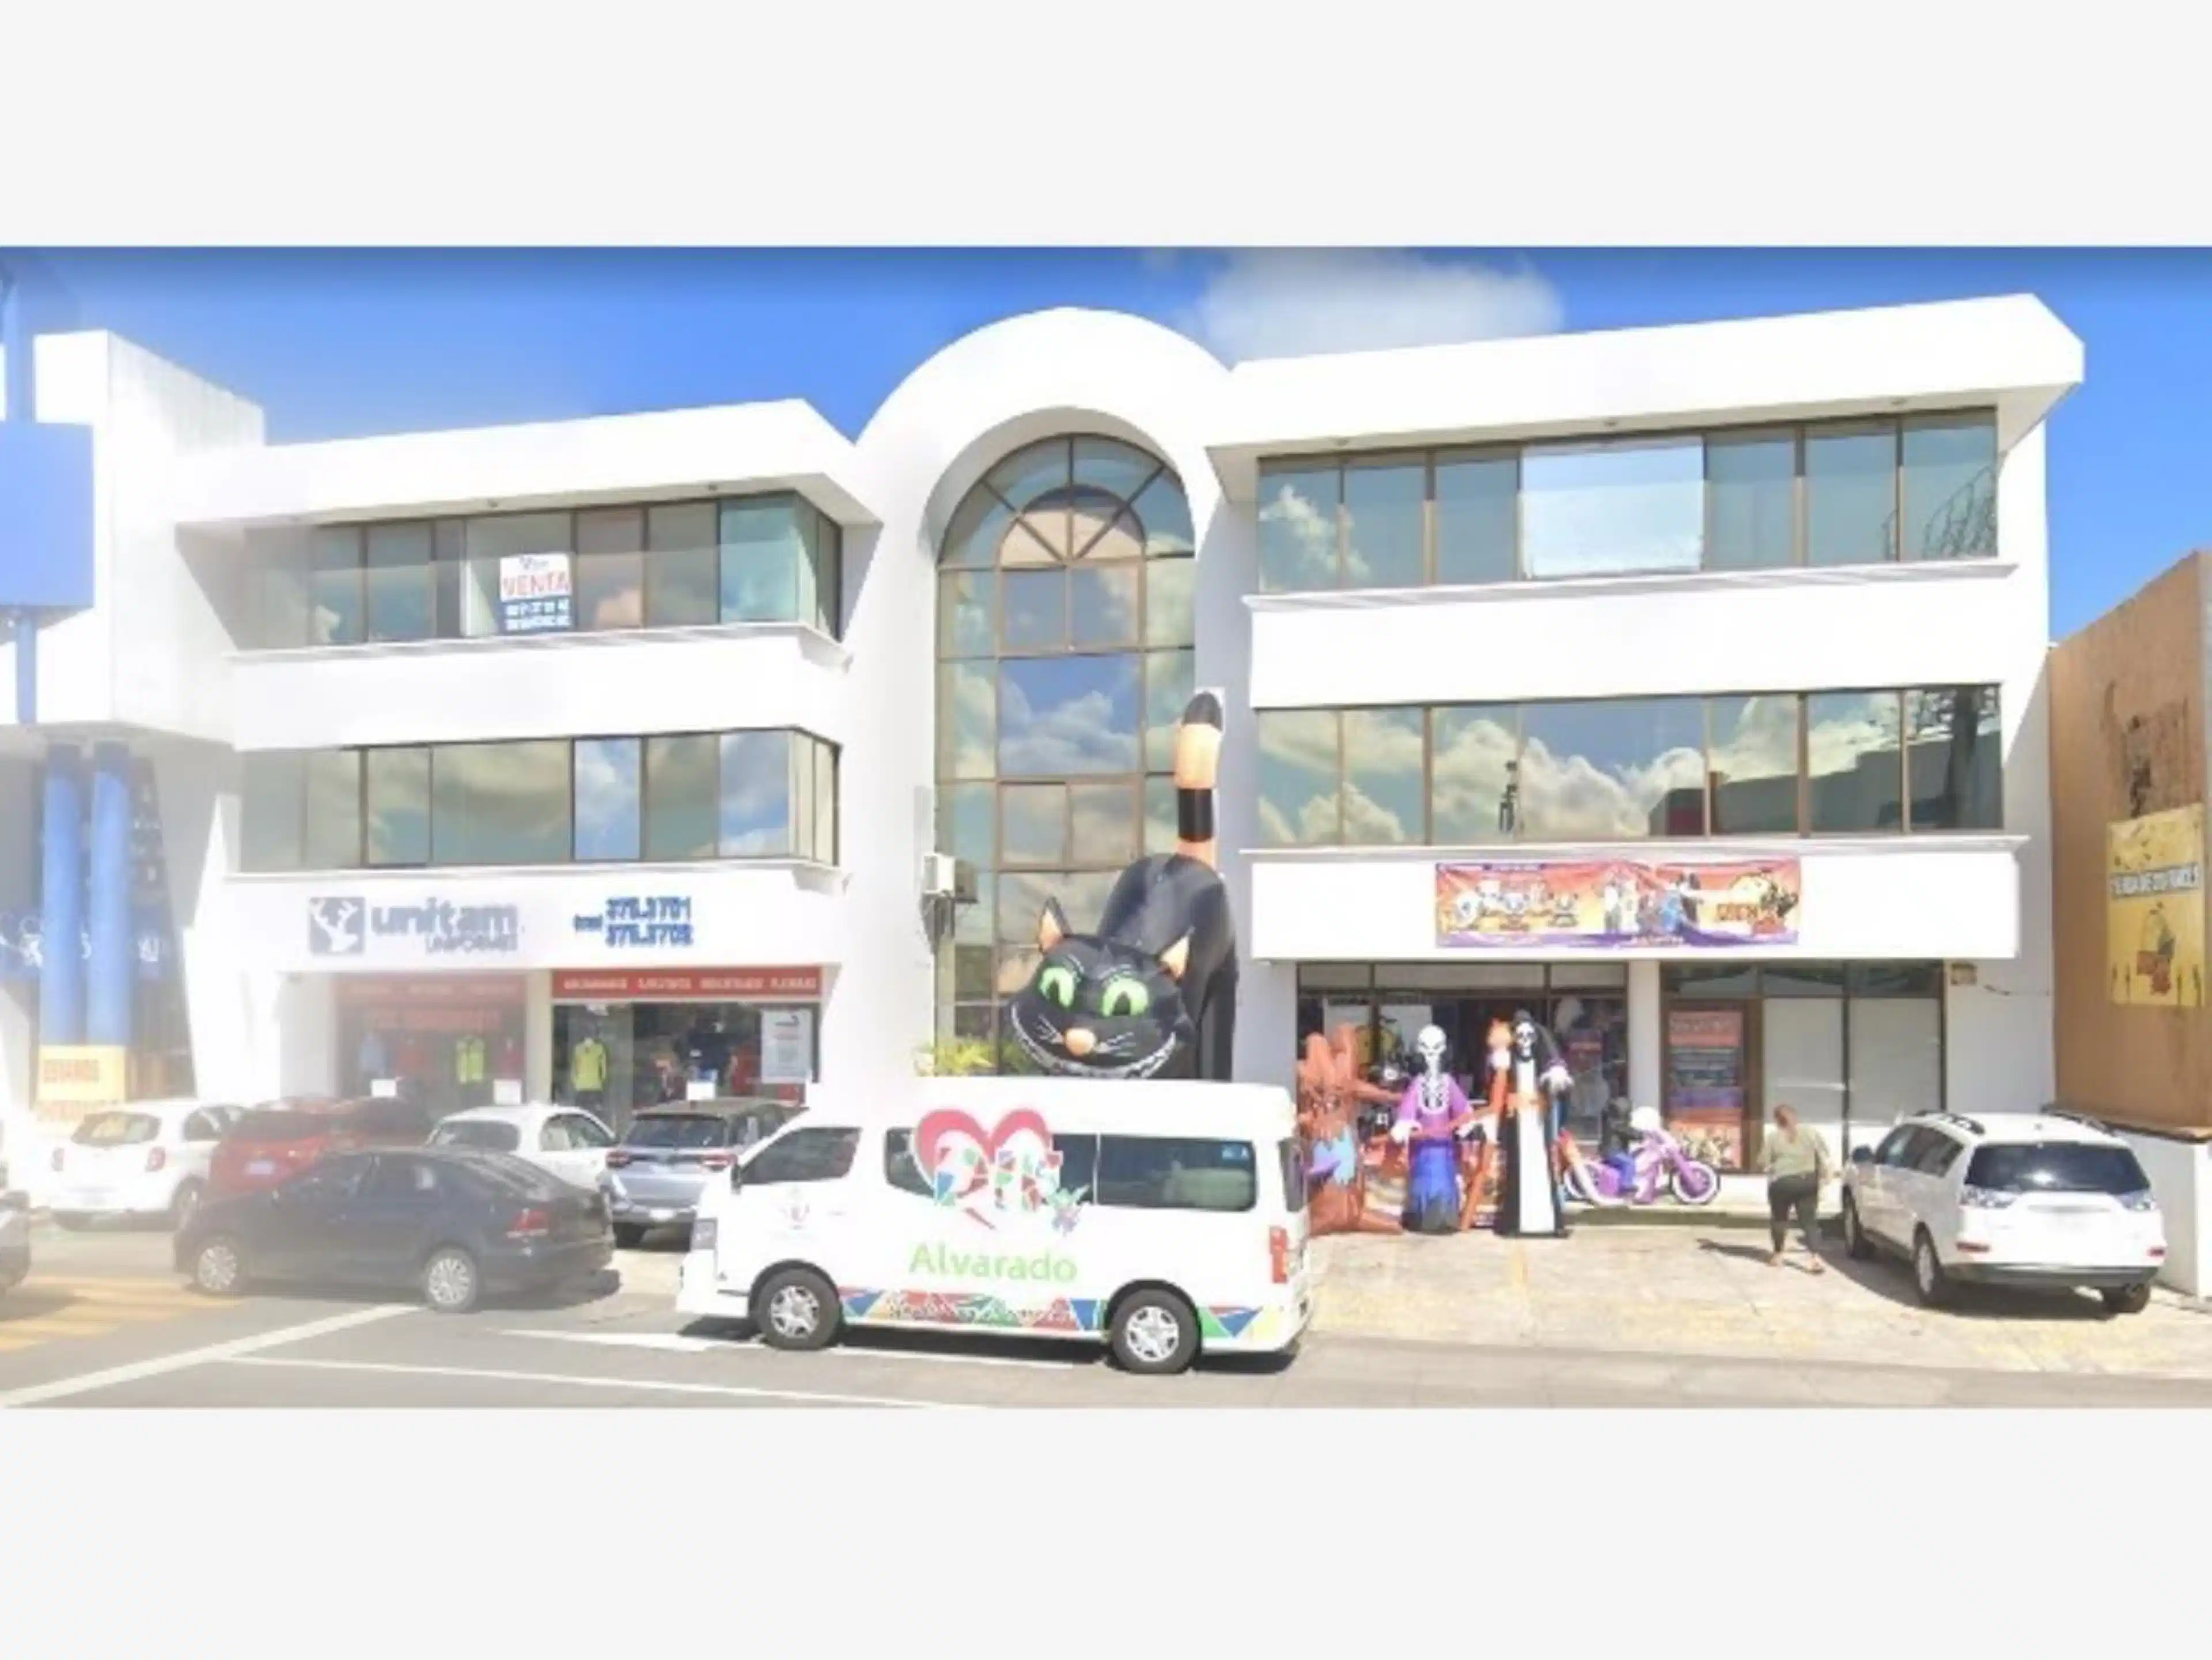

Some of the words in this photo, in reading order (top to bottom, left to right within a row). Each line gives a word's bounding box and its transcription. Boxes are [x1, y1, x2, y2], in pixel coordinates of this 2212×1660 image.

[502, 571, 570, 596] VENTA
[370, 896, 517, 935] unitam
[908, 1241, 1077, 1281] Alvarado
